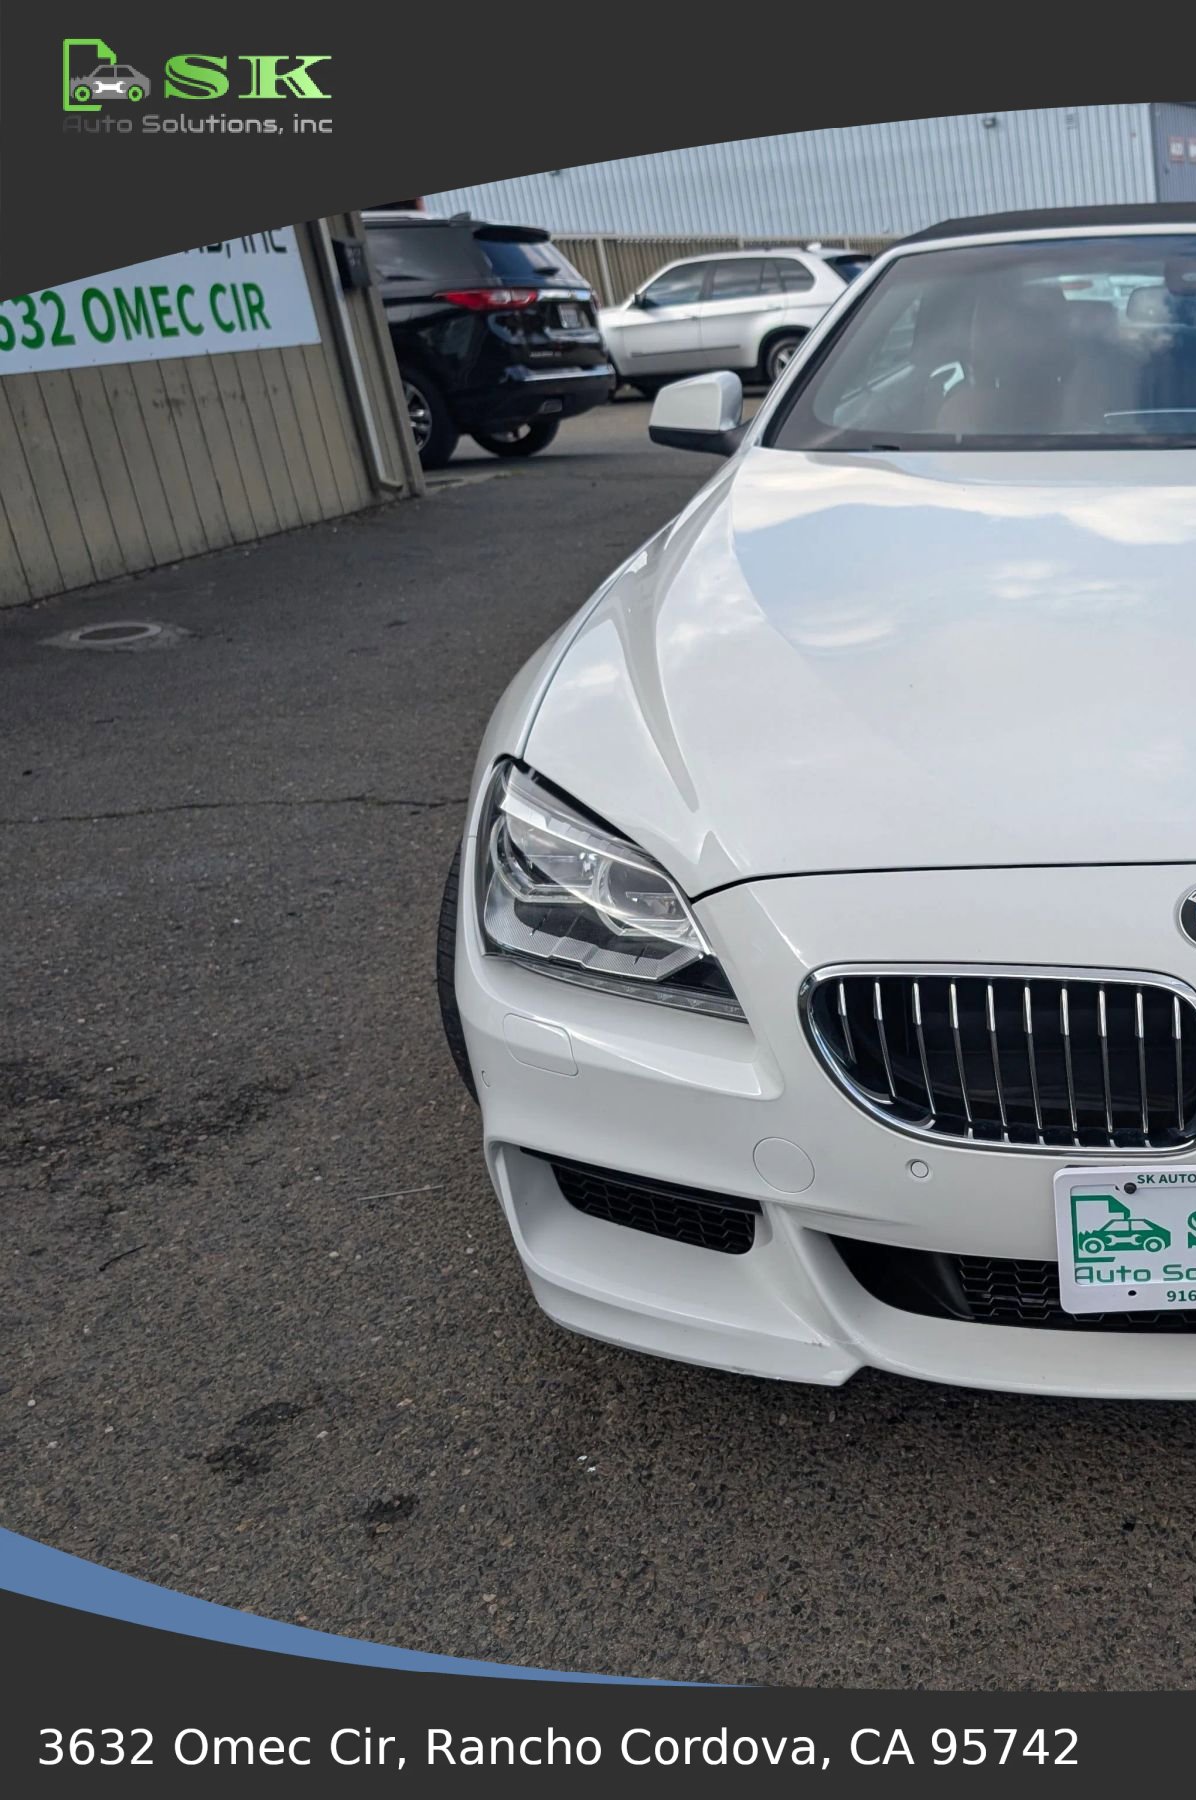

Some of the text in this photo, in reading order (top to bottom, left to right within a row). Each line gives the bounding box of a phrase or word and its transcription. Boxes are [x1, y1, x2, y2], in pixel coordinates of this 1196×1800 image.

[81, 287, 205, 343] OMEC
[208, 282, 272, 333] CIR
[1136, 1173, 1156, 1185] SK
[1074, 1265, 1152, 1284] Auto
